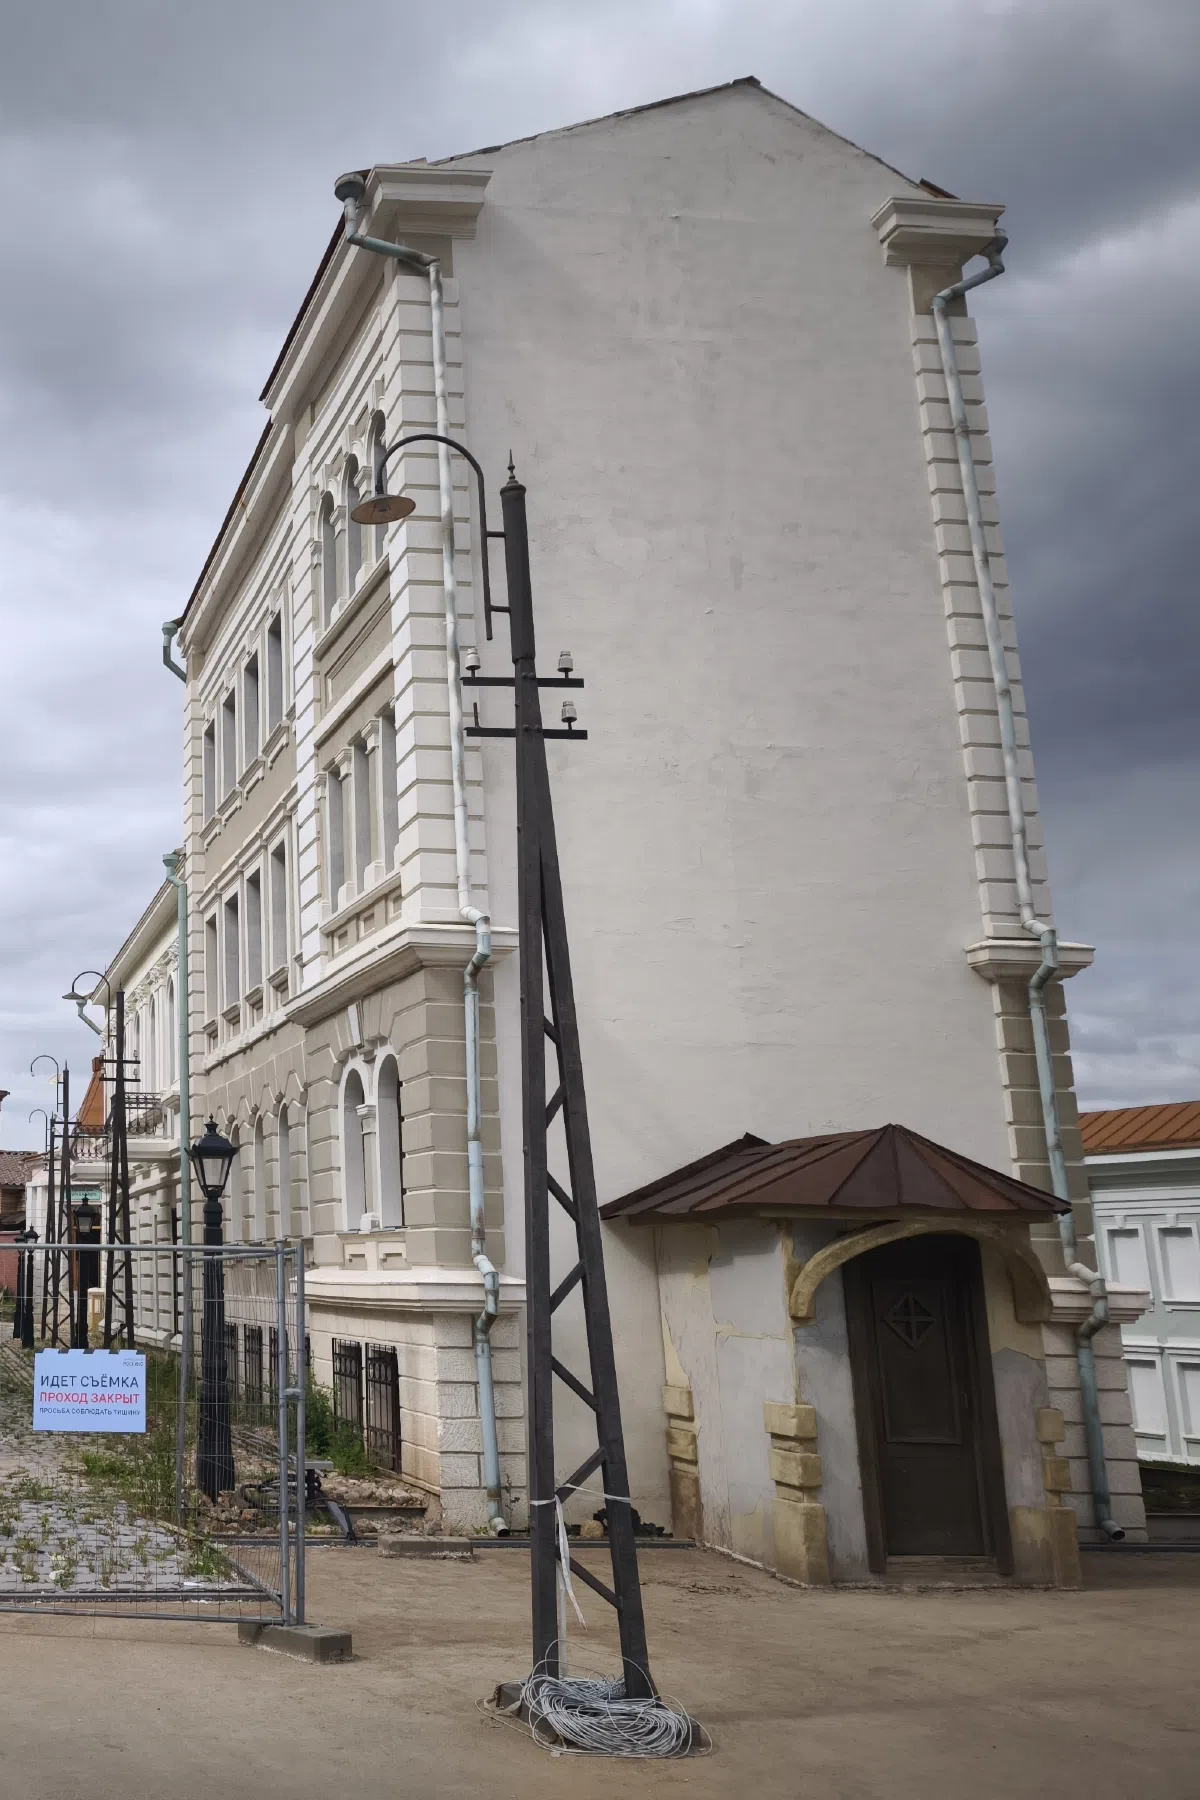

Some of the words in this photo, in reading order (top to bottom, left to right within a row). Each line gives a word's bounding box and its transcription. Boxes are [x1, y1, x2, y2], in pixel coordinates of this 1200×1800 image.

[40, 1375, 77, 1388] ИДЕТ
[80, 1374, 139, 1388] СЪЁМКА
[40, 1392, 88, 1404] ПРОХОД
[91, 1393, 140, 1404] ЗАКРЫТ
